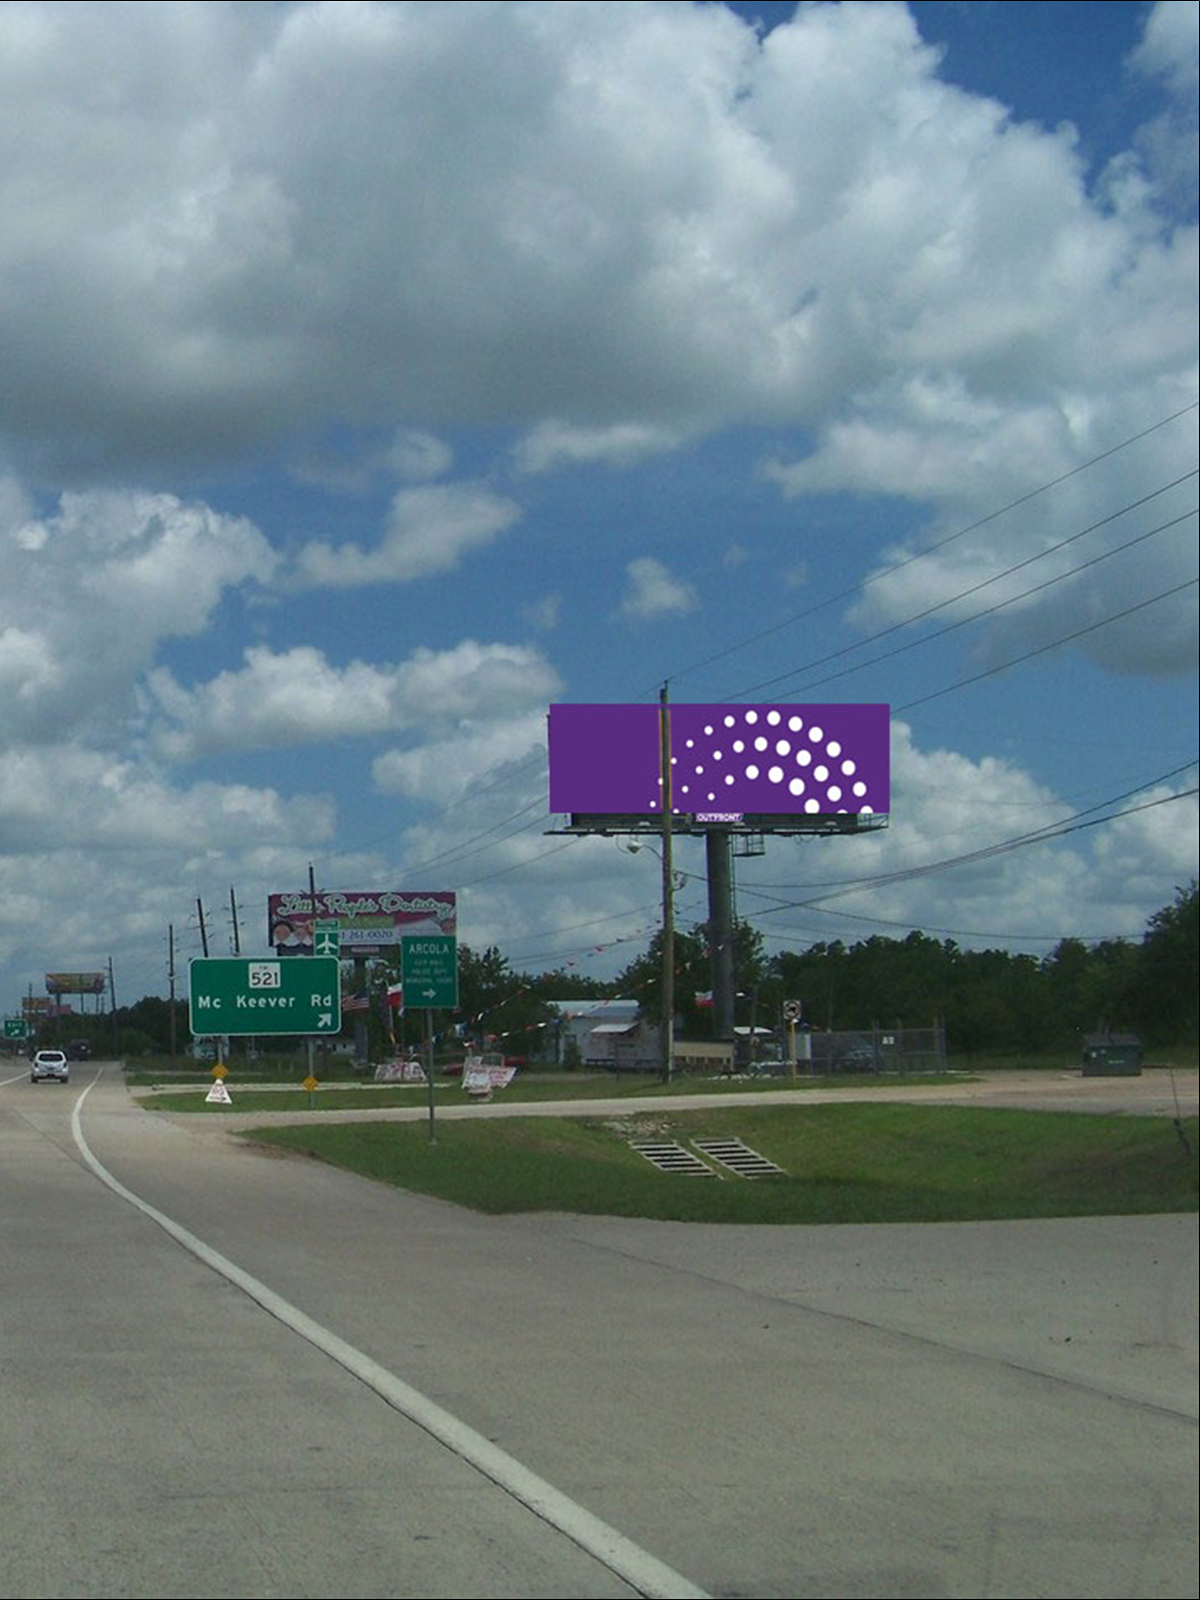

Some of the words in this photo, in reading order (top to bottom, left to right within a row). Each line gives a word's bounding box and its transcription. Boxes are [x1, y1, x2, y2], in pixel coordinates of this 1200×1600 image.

[696, 813, 742, 821] OUTFRONT
[409, 944, 450, 955] ARCOLA
[252, 972, 278, 986] 521
[198, 996, 221, 1009] Mc
[236, 995, 295, 1008] Keever
[311, 994, 332, 1006] Rd
